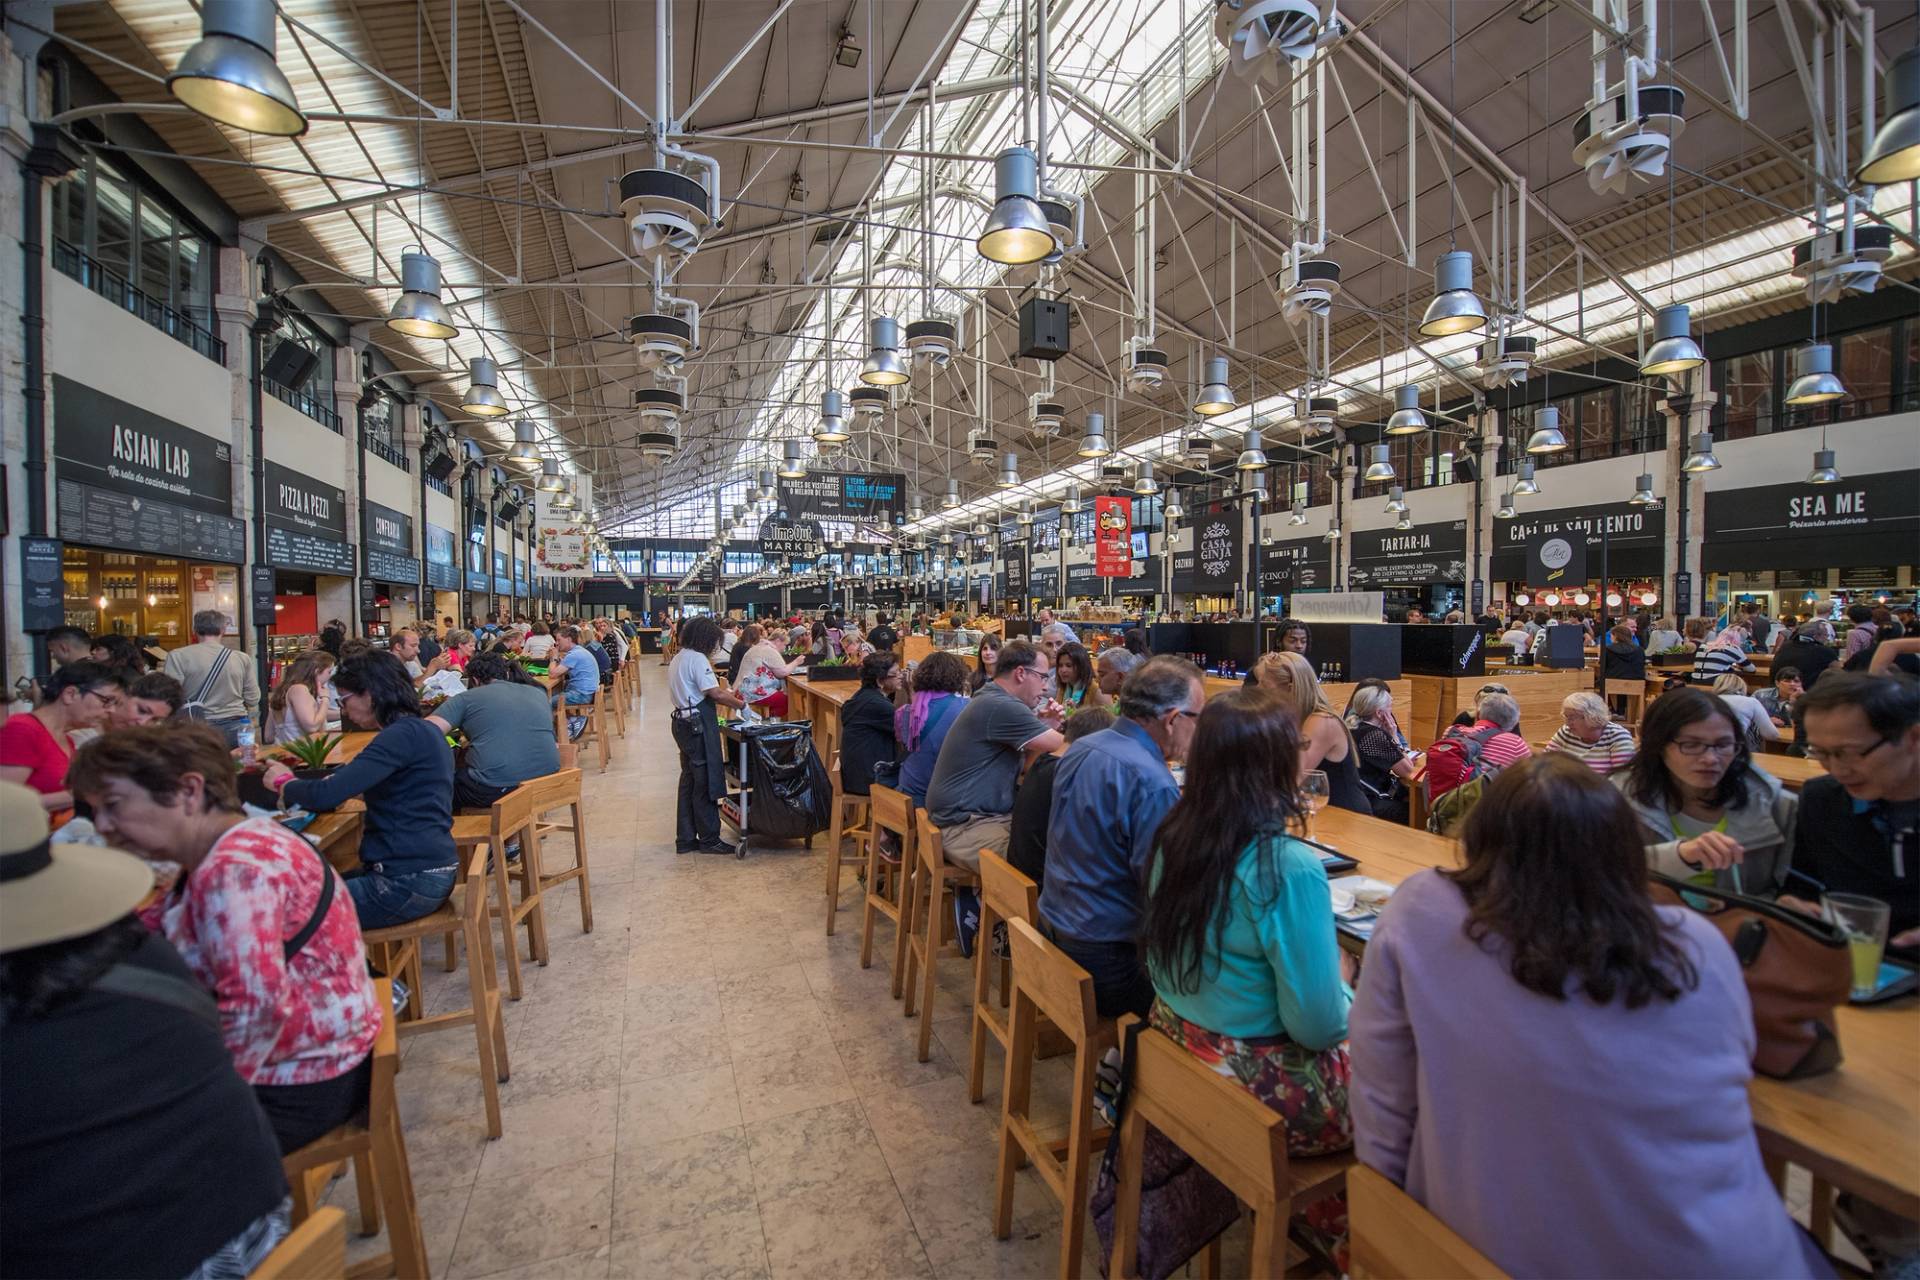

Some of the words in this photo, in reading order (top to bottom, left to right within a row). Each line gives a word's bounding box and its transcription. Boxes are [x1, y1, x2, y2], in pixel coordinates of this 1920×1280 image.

[112, 424, 160, 470] ASIAN
[165, 442, 190, 478] LAB
[782, 480, 803, 488] MILHÕES
[812, 482, 840, 490] VISITANTES
[794, 488, 814, 496] MELHOR
[280, 484, 302, 512] PIZZA
[304, 492, 309, 514] A
[310, 494, 329, 519] PEZZI
[1789, 496, 1826, 518] SEA
[1836, 492, 1866, 514] ME
[800, 512, 879, 523] #timeoutmarket3
[1789, 520, 1826, 529] Peixaria
[1826, 517, 1868, 526] moderna
[376, 516, 400, 540] CONFRARIA
[770, 523, 793, 541] Time
[794, 524, 813, 542] Out
[1200, 539, 1226, 551] CASA
[1381, 534, 1430, 552] TARTAR-IA
[1200, 548, 1232, 560] GINJA
[1390, 564, 1416, 572] EVERYTHING
[1264, 570, 1288, 580] CINCO
[1459, 630, 1481, 669] Schweppes
